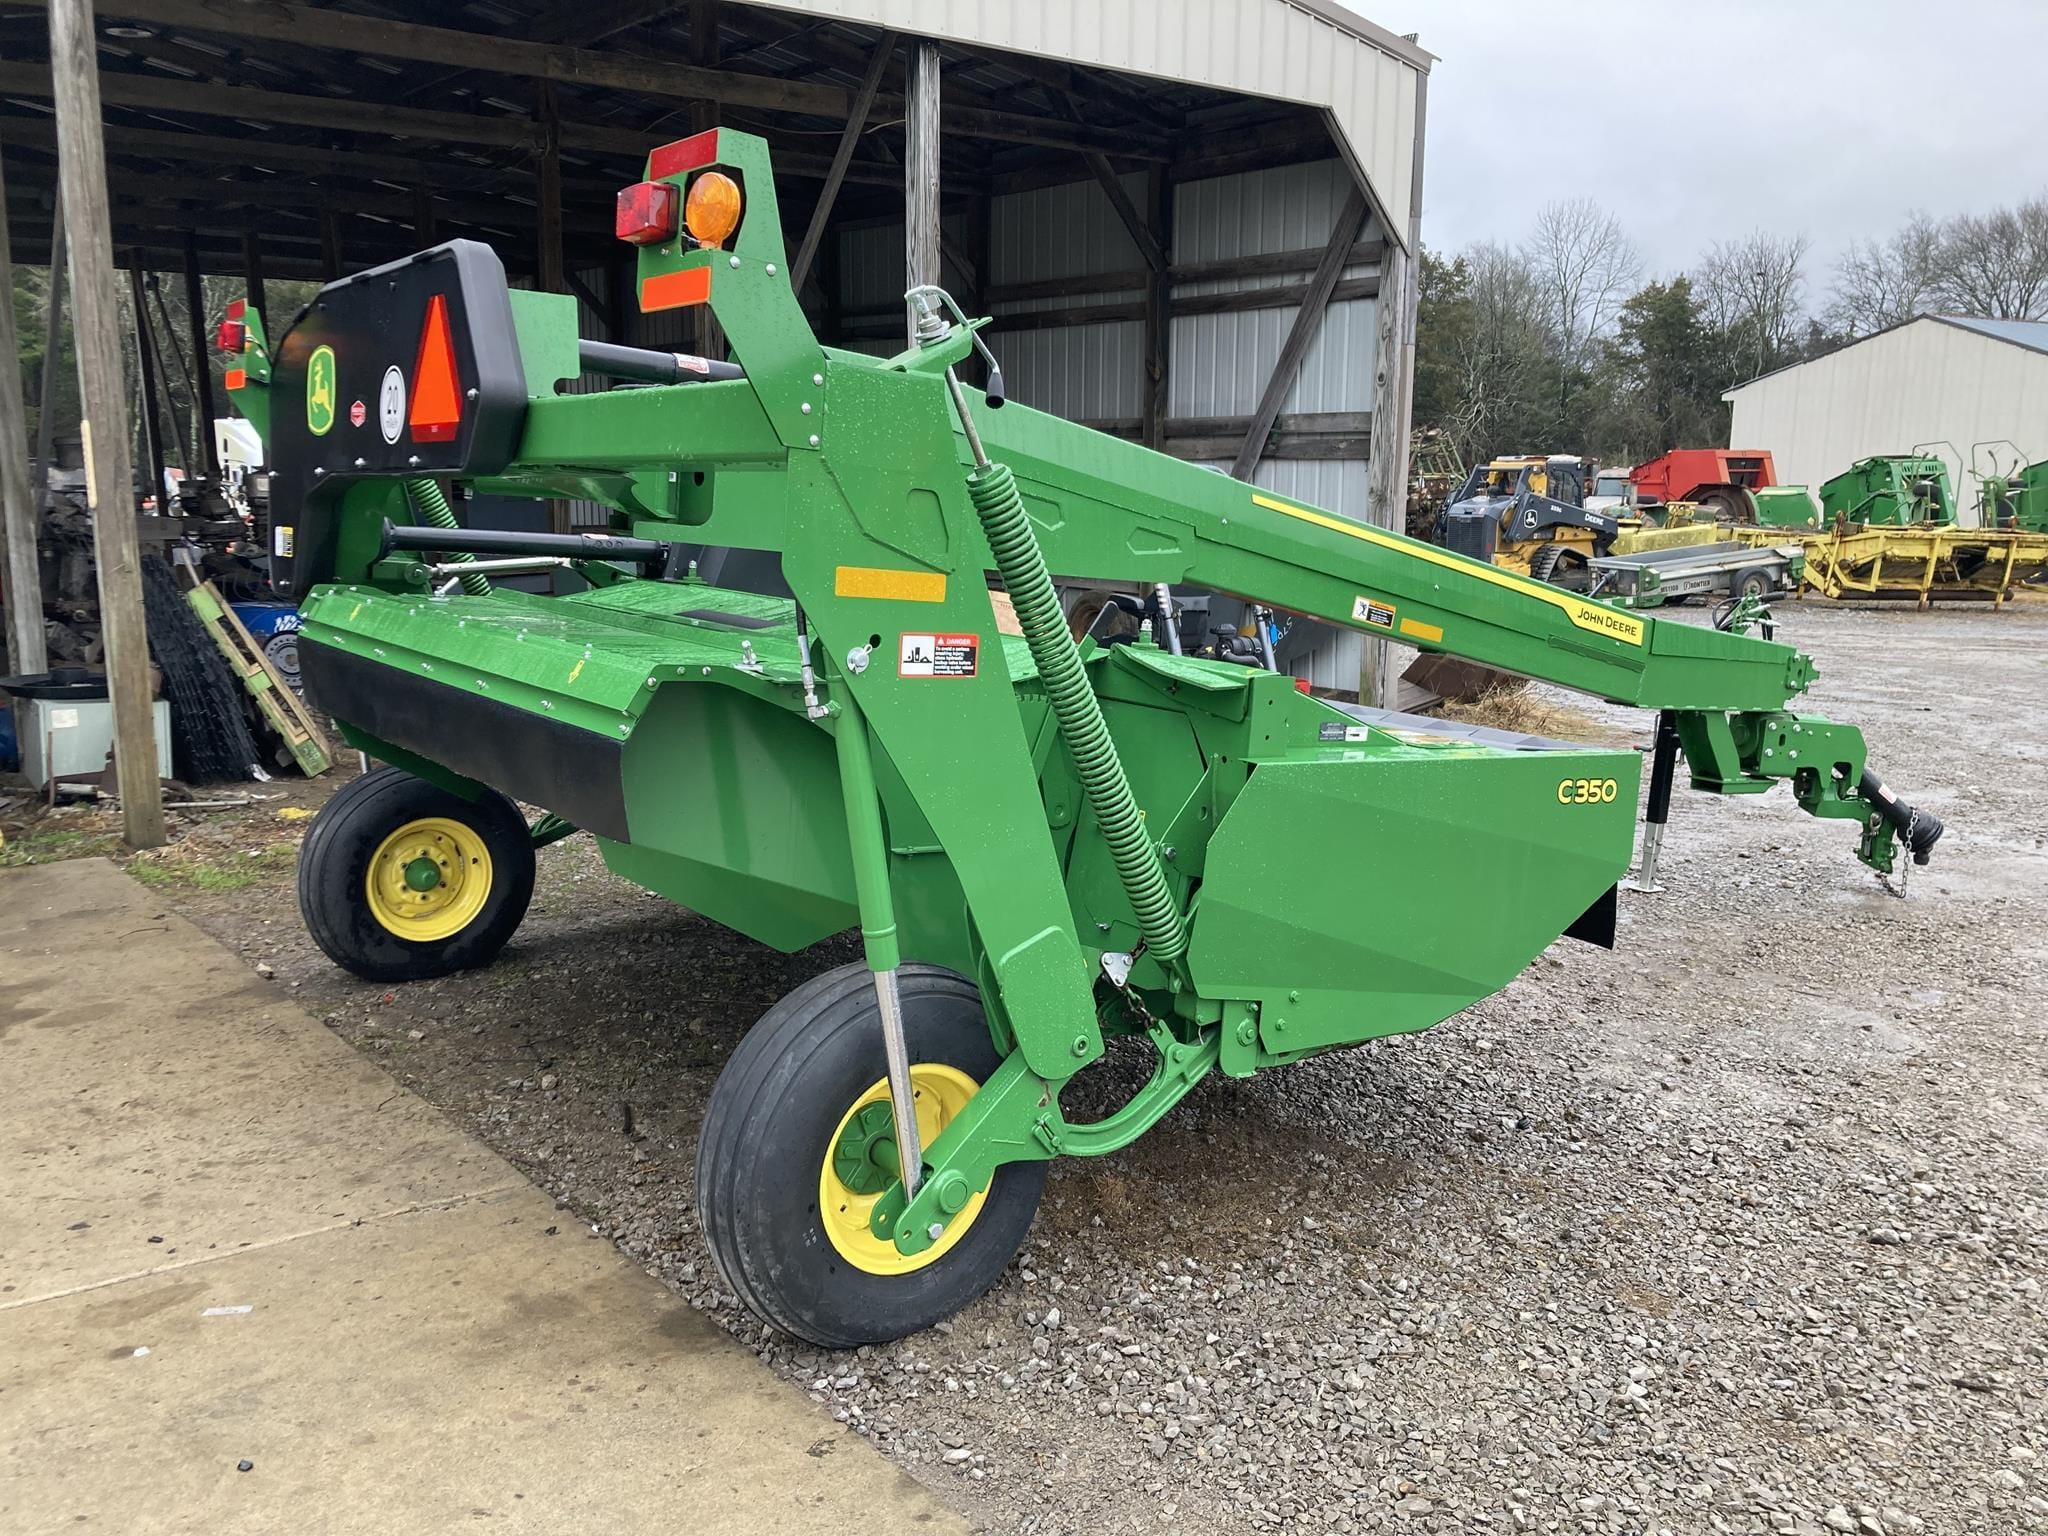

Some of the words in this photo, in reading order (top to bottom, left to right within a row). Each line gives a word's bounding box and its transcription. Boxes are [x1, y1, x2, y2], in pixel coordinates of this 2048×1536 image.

[1577, 608, 1604, 626] JOHN
[1605, 616, 1637, 636] DEERE
[1557, 778, 1618, 805] C350
